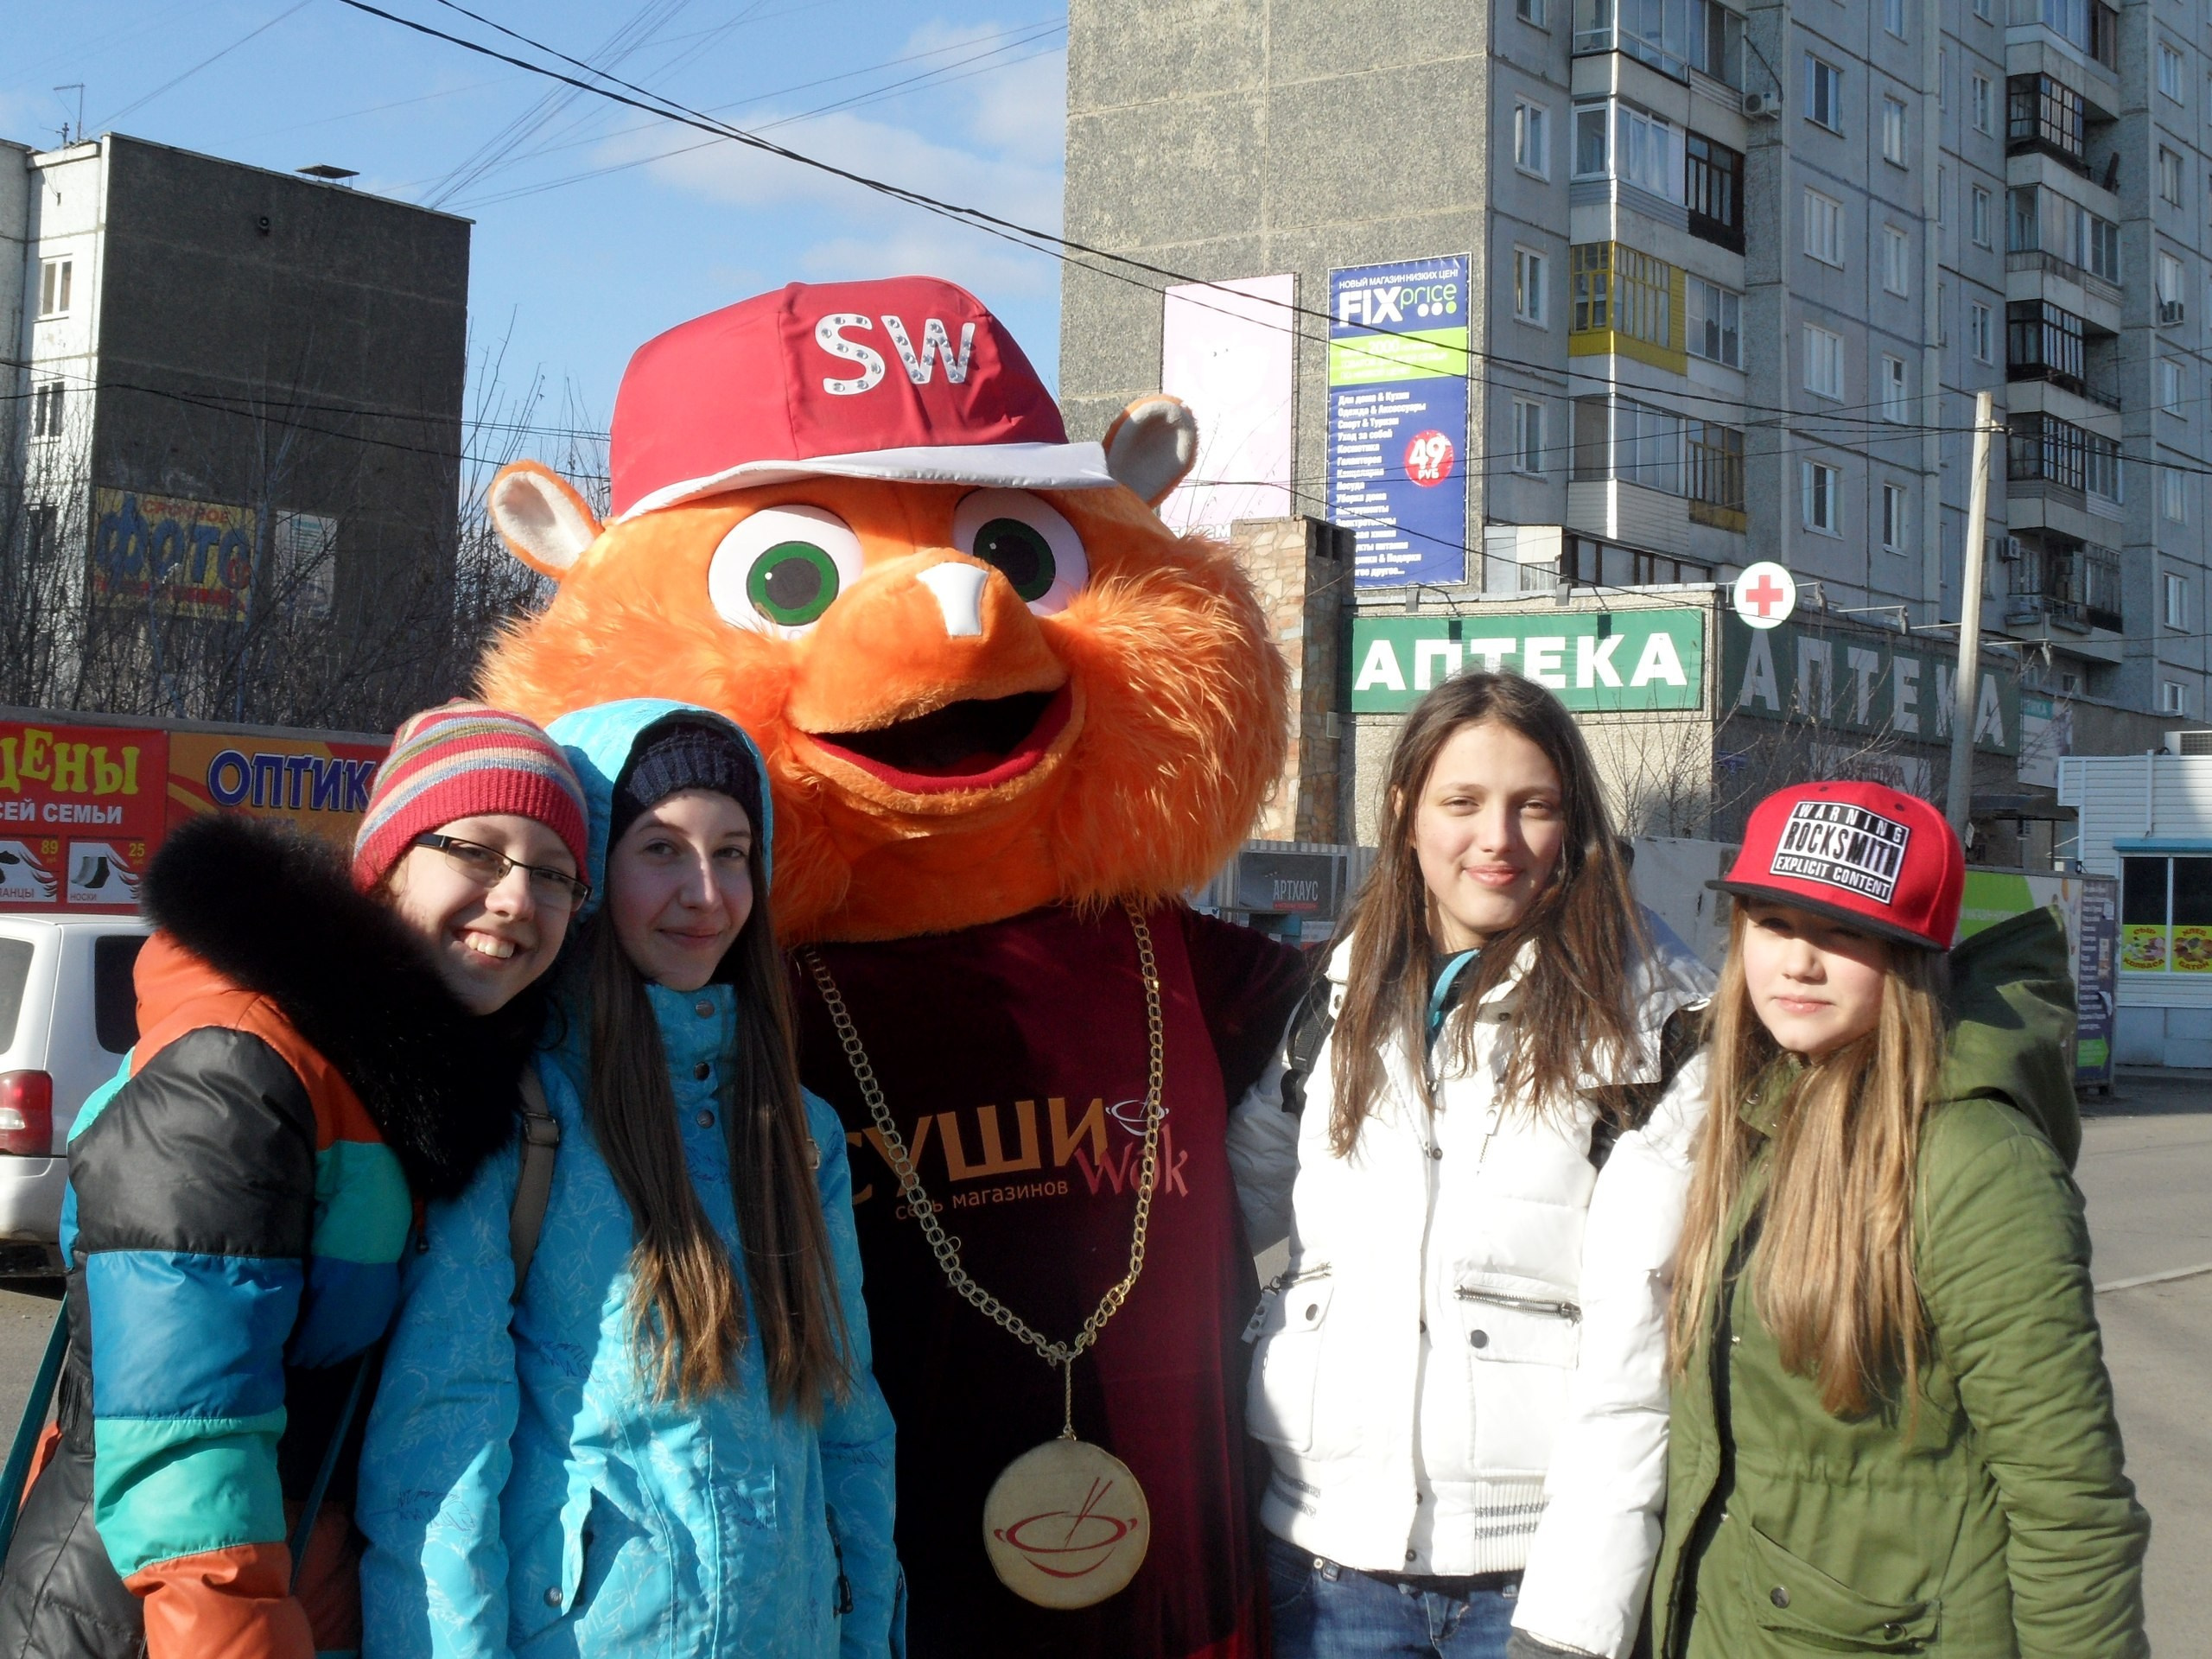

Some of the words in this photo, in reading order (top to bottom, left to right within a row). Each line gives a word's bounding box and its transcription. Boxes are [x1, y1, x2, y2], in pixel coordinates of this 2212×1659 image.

[1338, 277, 1368, 289] НОВЫЙ
[1369, 274, 1405, 286] МАГАЗИН
[1405, 270, 1437, 283] НИЗКИХ
[1339, 286, 1403, 327] FIX
[1400, 283, 1457, 310] price
[814, 313, 976, 396] SW
[1377, 392, 1384, 402] &
[1338, 407, 1369, 417] Одежда
[1370, 405, 1377, 415] &
[1338, 420, 1361, 429] Спорт
[1362, 418, 1369, 427] &
[1338, 432, 1357, 442] Уход
[1369, 429, 1393, 439] собой
[1337, 444, 1380, 454] Косметика
[1408, 436, 1447, 471] 49
[1418, 468, 1440, 480] РУБ
[95, 493, 251, 589] ФОТО
[1378, 554, 1386, 563] &
[1353, 632, 1688, 691] АПТЕКА
[1738, 629, 2005, 747] АПТЕКА
[207, 749, 376, 811] ОПТИК
[0, 798, 35, 822] ЕЙ
[42, 803, 123, 824] СЕМЬИ
[1798, 804, 1904, 843] WARNING
[41, 840, 59, 855] 89
[129, 842, 145, 857] 25
[1783, 821, 1901, 877] ROCKSMITH
[1776, 857, 1830, 878] EXPLICIT
[1833, 867, 1891, 897] CONTENT
[0, 887, 35, 899] АНЦЫ
[70, 893, 97, 901] НОСКИ
[1273, 880, 1319, 901] АРТХАУС
[2123, 957, 2165, 969] КОЛБАСА
[895, 1200, 944, 1220] сеь
[953, 1180, 1069, 1210] магазинов
